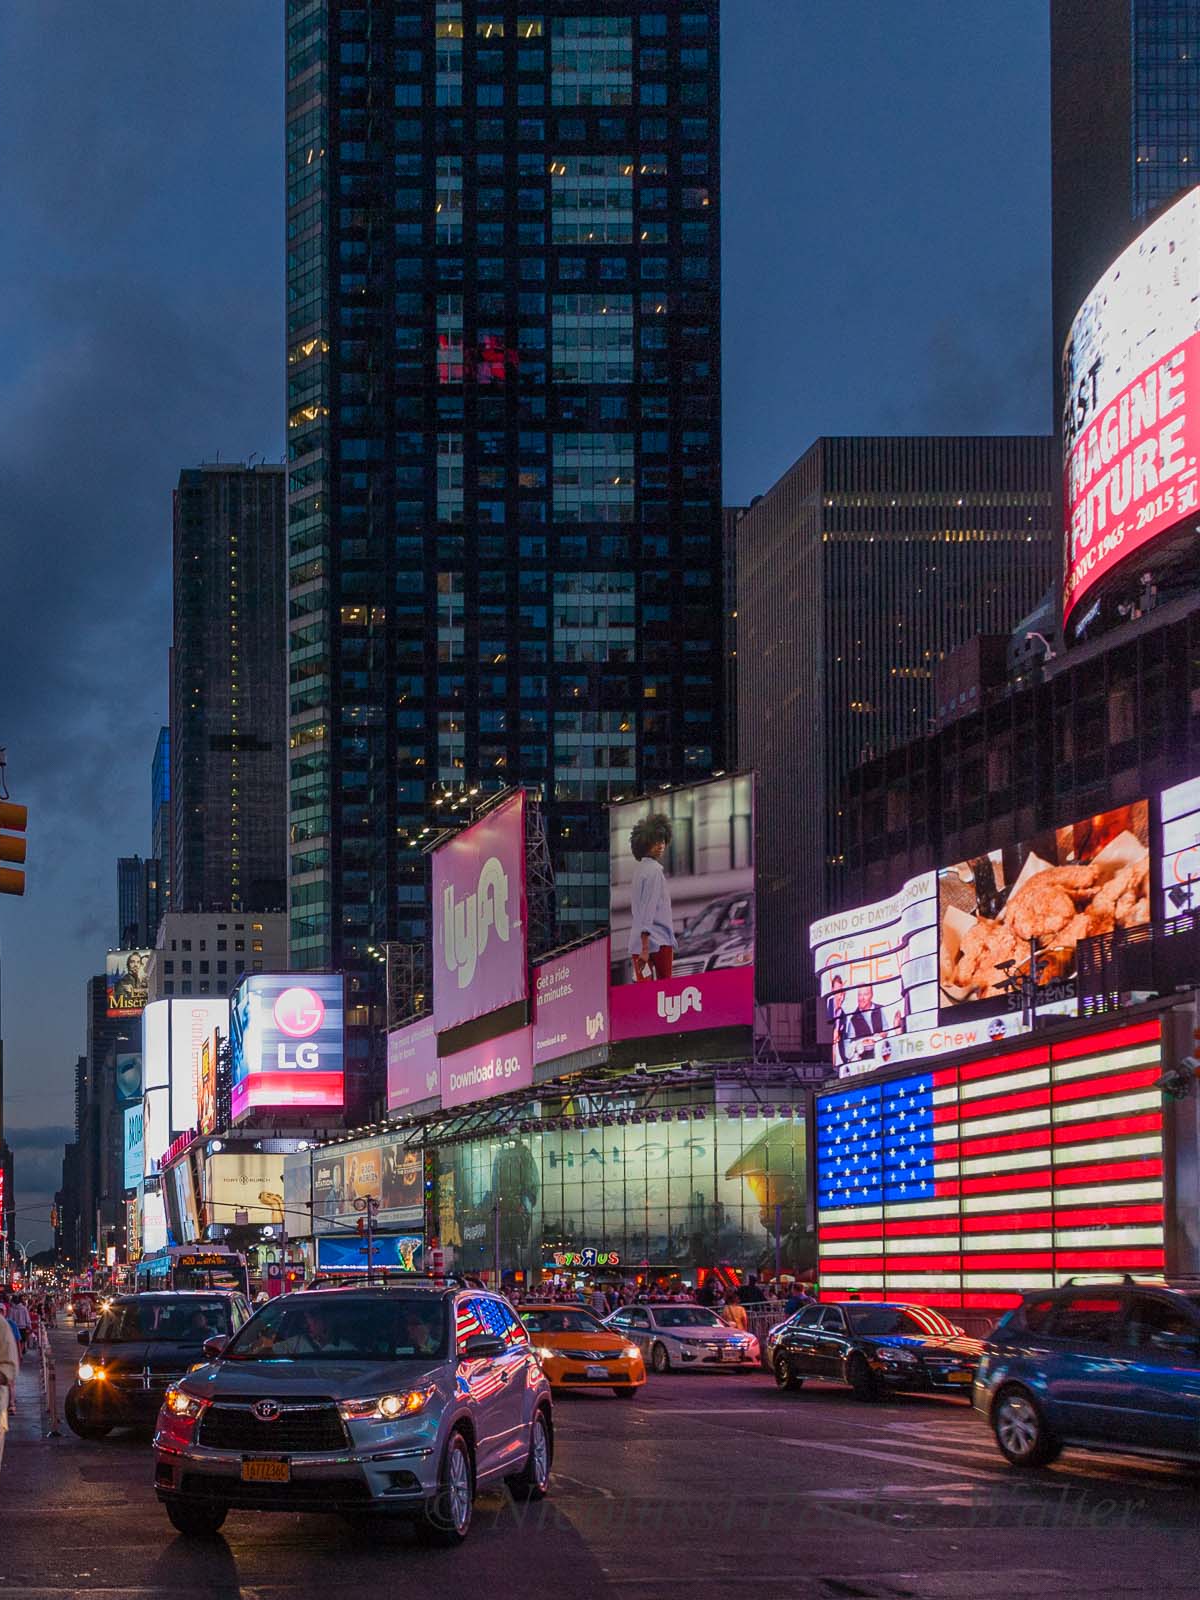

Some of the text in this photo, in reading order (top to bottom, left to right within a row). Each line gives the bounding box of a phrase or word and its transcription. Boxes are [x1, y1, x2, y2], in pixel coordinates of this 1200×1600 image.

[1098, 522, 1125, 562] 1965
[1136, 486, 1175, 530] 2015
[443, 856, 510, 989] lyft
[824, 919, 848, 935] KIND
[536, 976, 549, 990] Get
[554, 967, 570, 983] ride
[536, 993, 544, 1006] in
[657, 986, 702, 1023] lyft
[586, 1011, 604, 1040] lyft
[277, 1042, 319, 1069] LG
[898, 1039, 924, 1056] The
[929, 1030, 977, 1050] Chew
[450, 1055, 521, 1092] Download & go.
